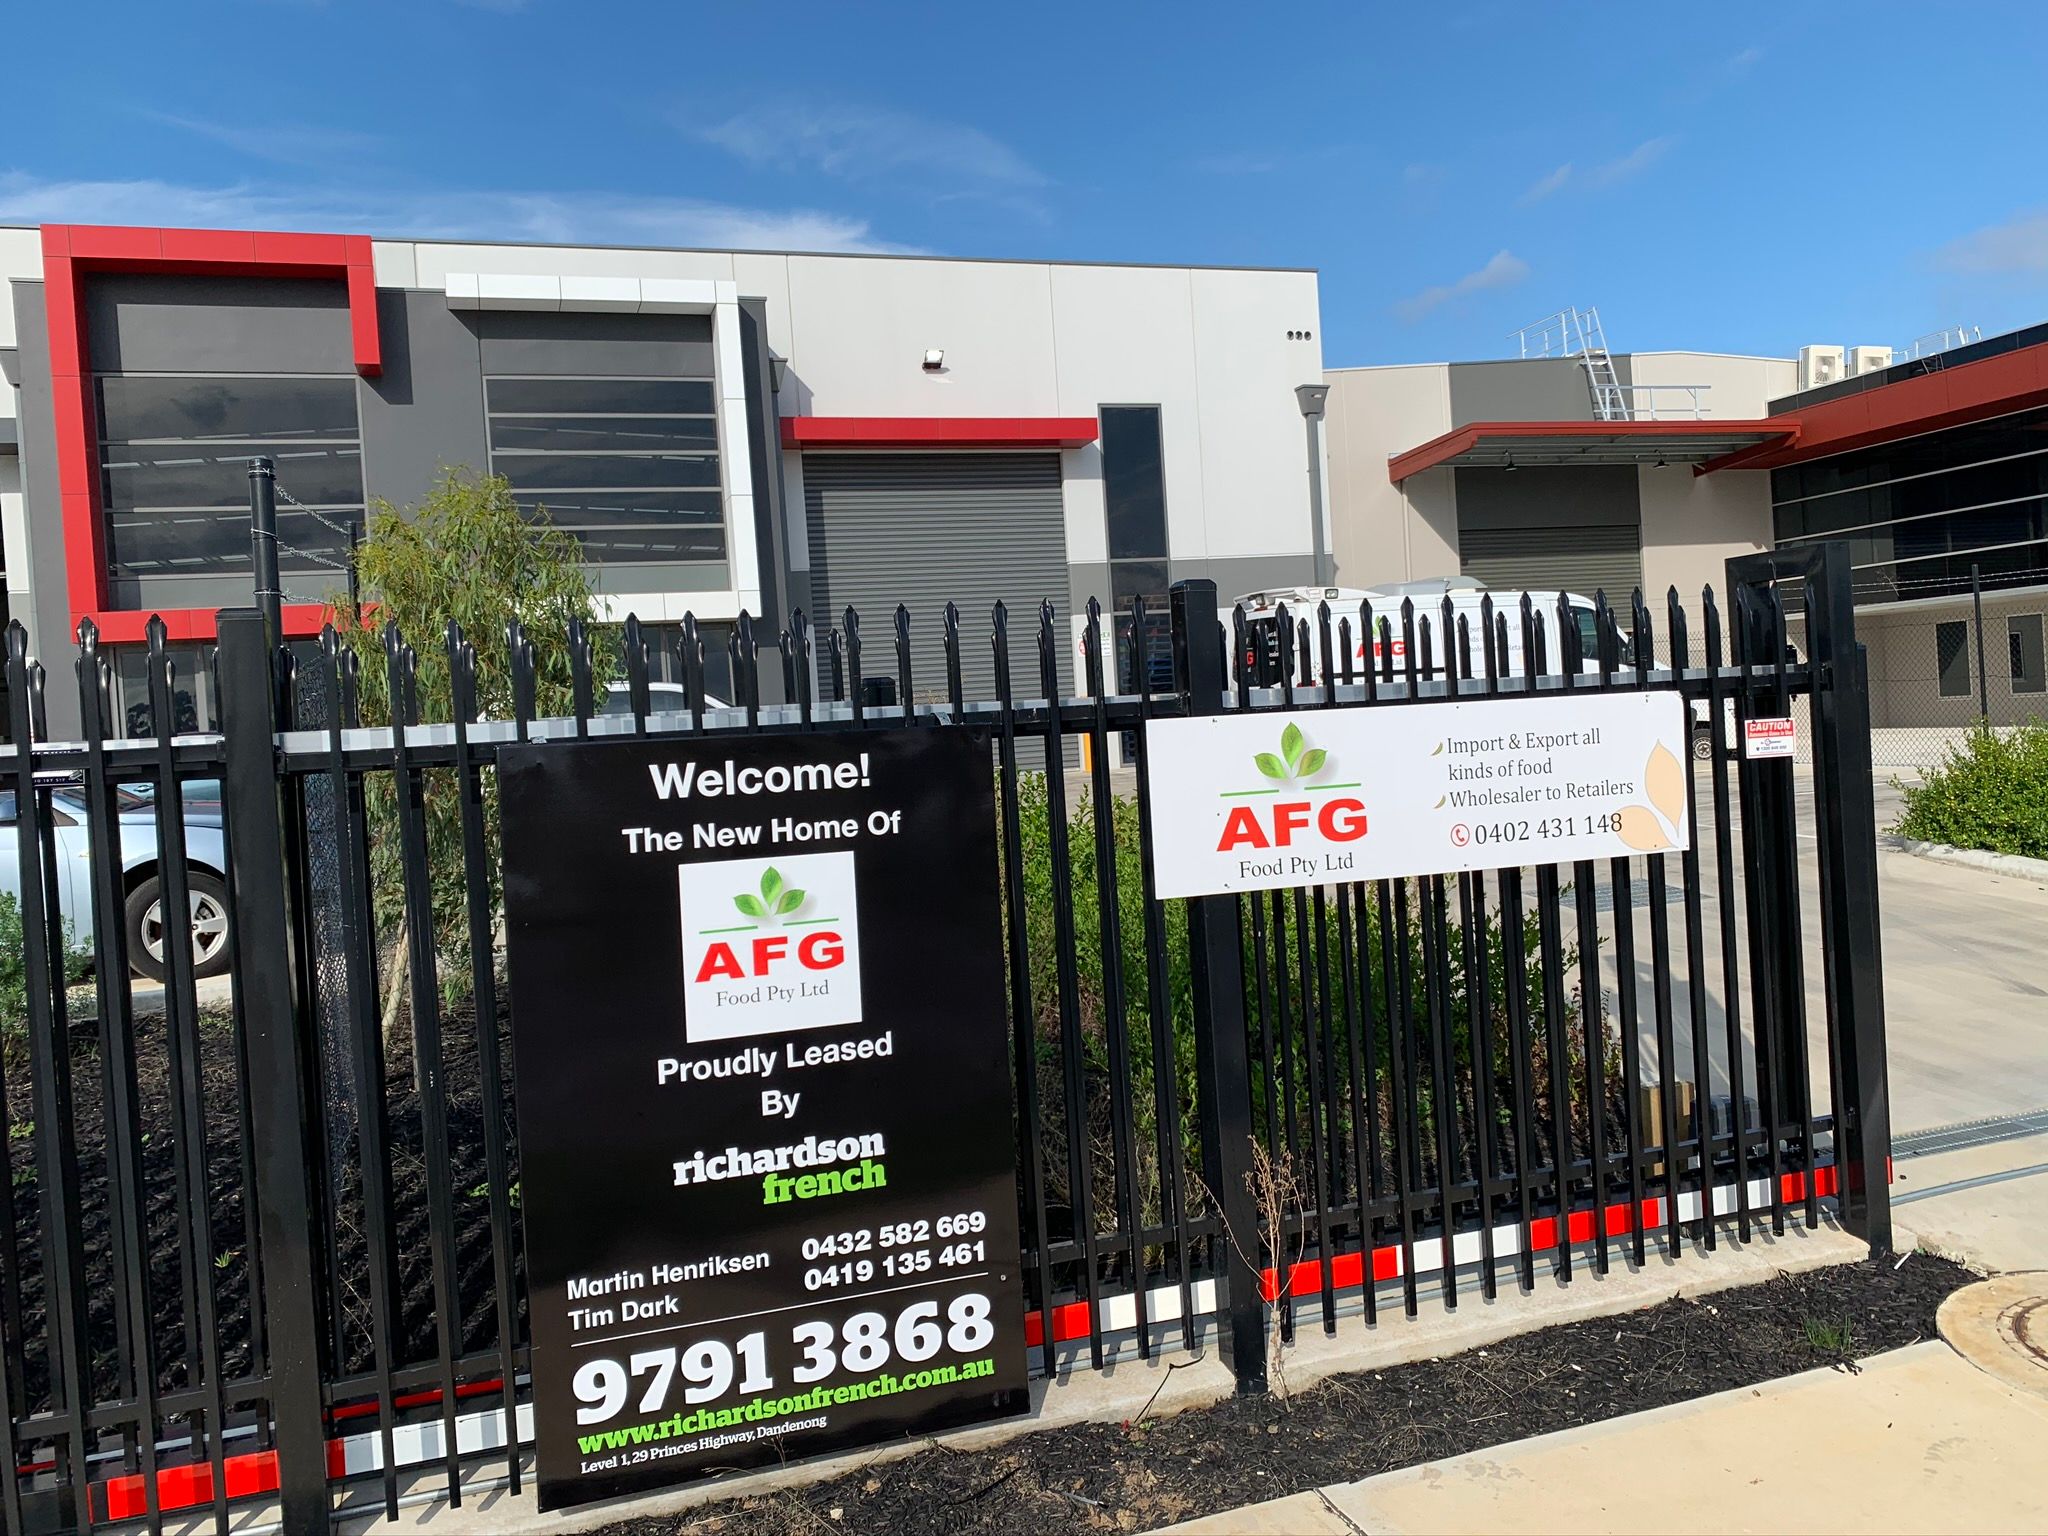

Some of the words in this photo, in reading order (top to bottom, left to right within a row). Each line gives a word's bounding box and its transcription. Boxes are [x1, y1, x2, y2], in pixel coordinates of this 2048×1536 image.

[1448, 737, 1504, 756] Import
[1509, 734, 1521, 749] &
[1527, 732, 1577, 751] Export
[1583, 728, 1600, 744] all
[1749, 721, 1791, 732] CAUTION
[649, 753, 870, 799] Welcome!
[1449, 762, 1492, 780] kinds
[1498, 762, 1512, 777] of
[1518, 758, 1552, 775] food
[1450, 786, 1541, 807] Wholesaler
[1546, 787, 1560, 800] to
[1567, 780, 1633, 798] Retailers
[622, 828, 682, 853] The
[693, 823, 761, 848] New
[772, 818, 858, 842] Home
[868, 810, 900, 835] Of
[1218, 799, 1367, 851] AFG
[1476, 821, 1529, 844] 0402
[1537, 818, 1576, 838] 431
[1585, 813, 1622, 834] 148
[1240, 858, 1282, 878] Food
[1291, 857, 1317, 877] Pty
[1326, 852, 1353, 870] Ltd
[697, 932, 844, 982] AFG
[718, 987, 760, 1006] Food
[768, 986, 794, 1002] Pty
[801, 979, 828, 997] Ltd
[658, 1048, 777, 1084] Proudly
[787, 1031, 892, 1068] Leased
[762, 1090, 800, 1118] By
[673, 1133, 886, 1187] richardson
[763, 1159, 887, 1204] french
[802, 1230, 871, 1259] 0432
[879, 1220, 929, 1248] 582
[937, 1211, 985, 1237] 669
[568, 1271, 644, 1300] Martin
[652, 1253, 769, 1283] Henriksen
[804, 1260, 874, 1291] 0419
[882, 1251, 931, 1277] 135
[939, 1240, 984, 1266] 461
[568, 1309, 613, 1330] Tim
[622, 1295, 679, 1321] Dark
[572, 1331, 773, 1426] 9791
[792, 1293, 994, 1383] 3868
[578, 1359, 995, 1455] www.richardsonfrench.com.au
[581, 1456, 617, 1474] Level
[632, 1450, 648, 1463] 29
[650, 1442, 697, 1459] Princes
[699, 1431, 755, 1450] Highway,
[757, 1413, 827, 1439] Dandenong
